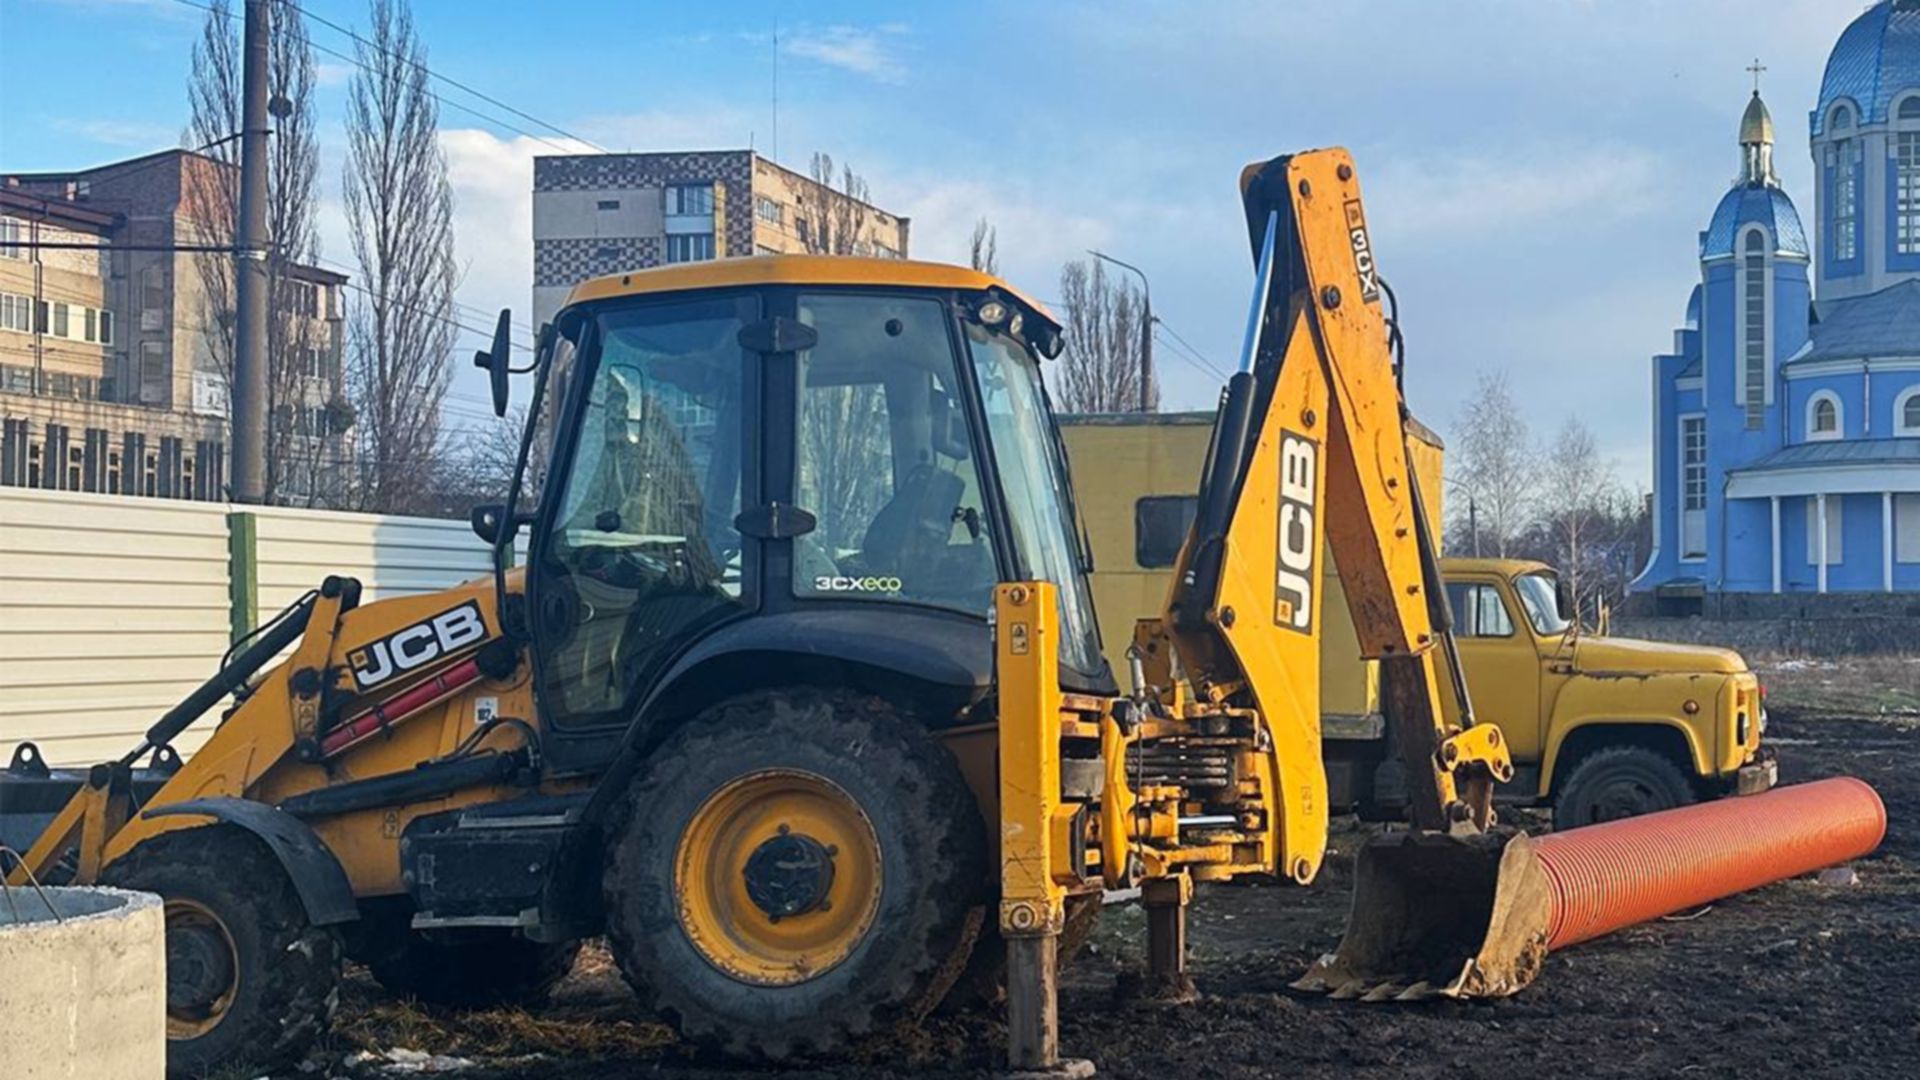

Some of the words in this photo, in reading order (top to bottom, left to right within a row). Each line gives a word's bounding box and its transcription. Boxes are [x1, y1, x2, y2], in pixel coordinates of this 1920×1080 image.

[1351, 229, 1377, 294] 3CX
[1279, 437, 1316, 628] JCB
[357, 605, 485, 686] JCB
